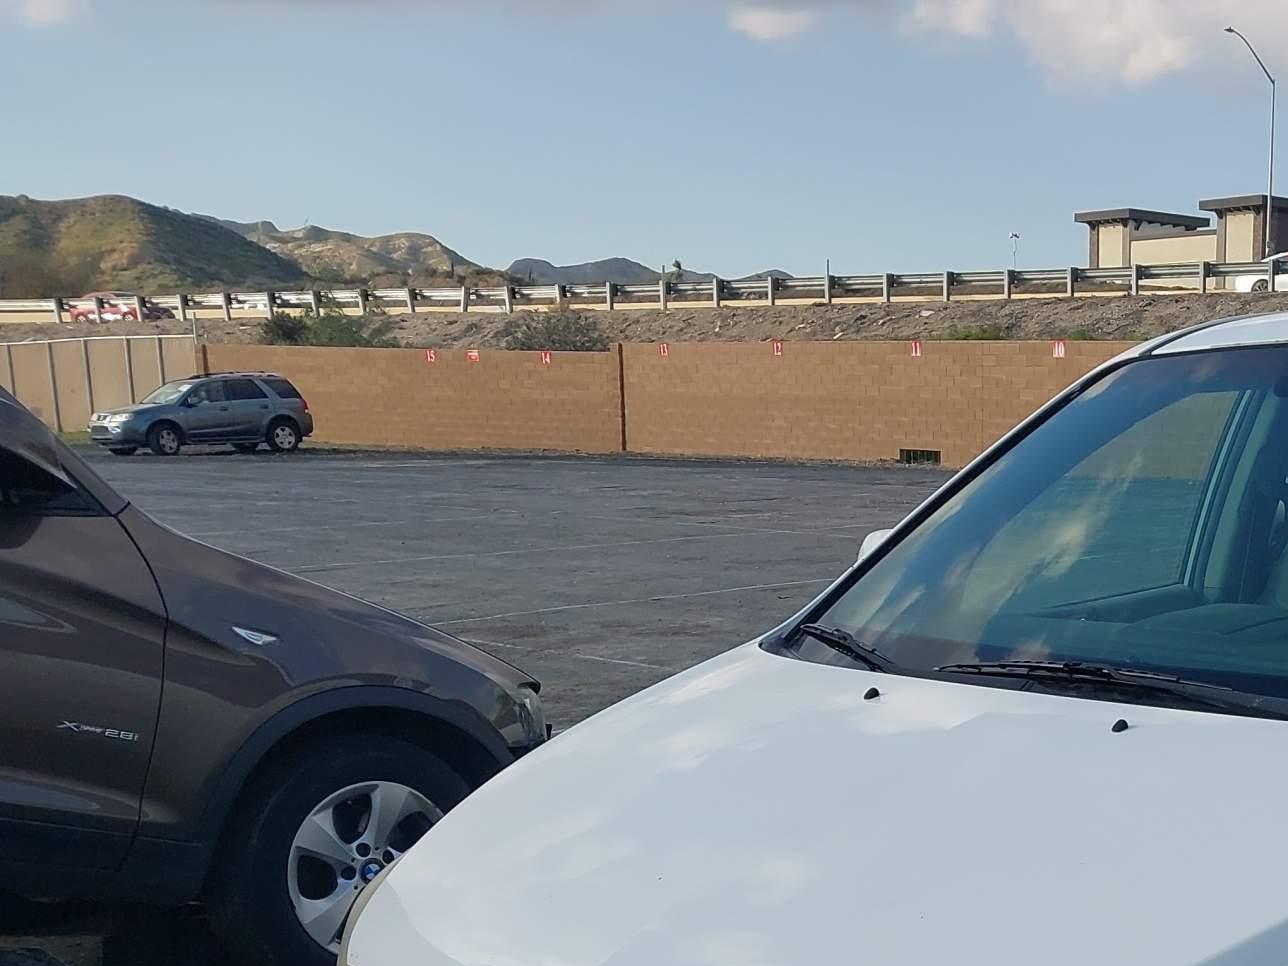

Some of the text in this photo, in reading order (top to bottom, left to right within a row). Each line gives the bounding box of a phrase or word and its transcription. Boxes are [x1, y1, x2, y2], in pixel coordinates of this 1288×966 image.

[660, 343, 668, 356] 13
[773, 342, 782, 355] 12
[911, 342, 921, 356] 11
[1054, 342, 1065, 358] 10
[426, 350, 435, 362] 15
[541, 352, 550, 364] 14
